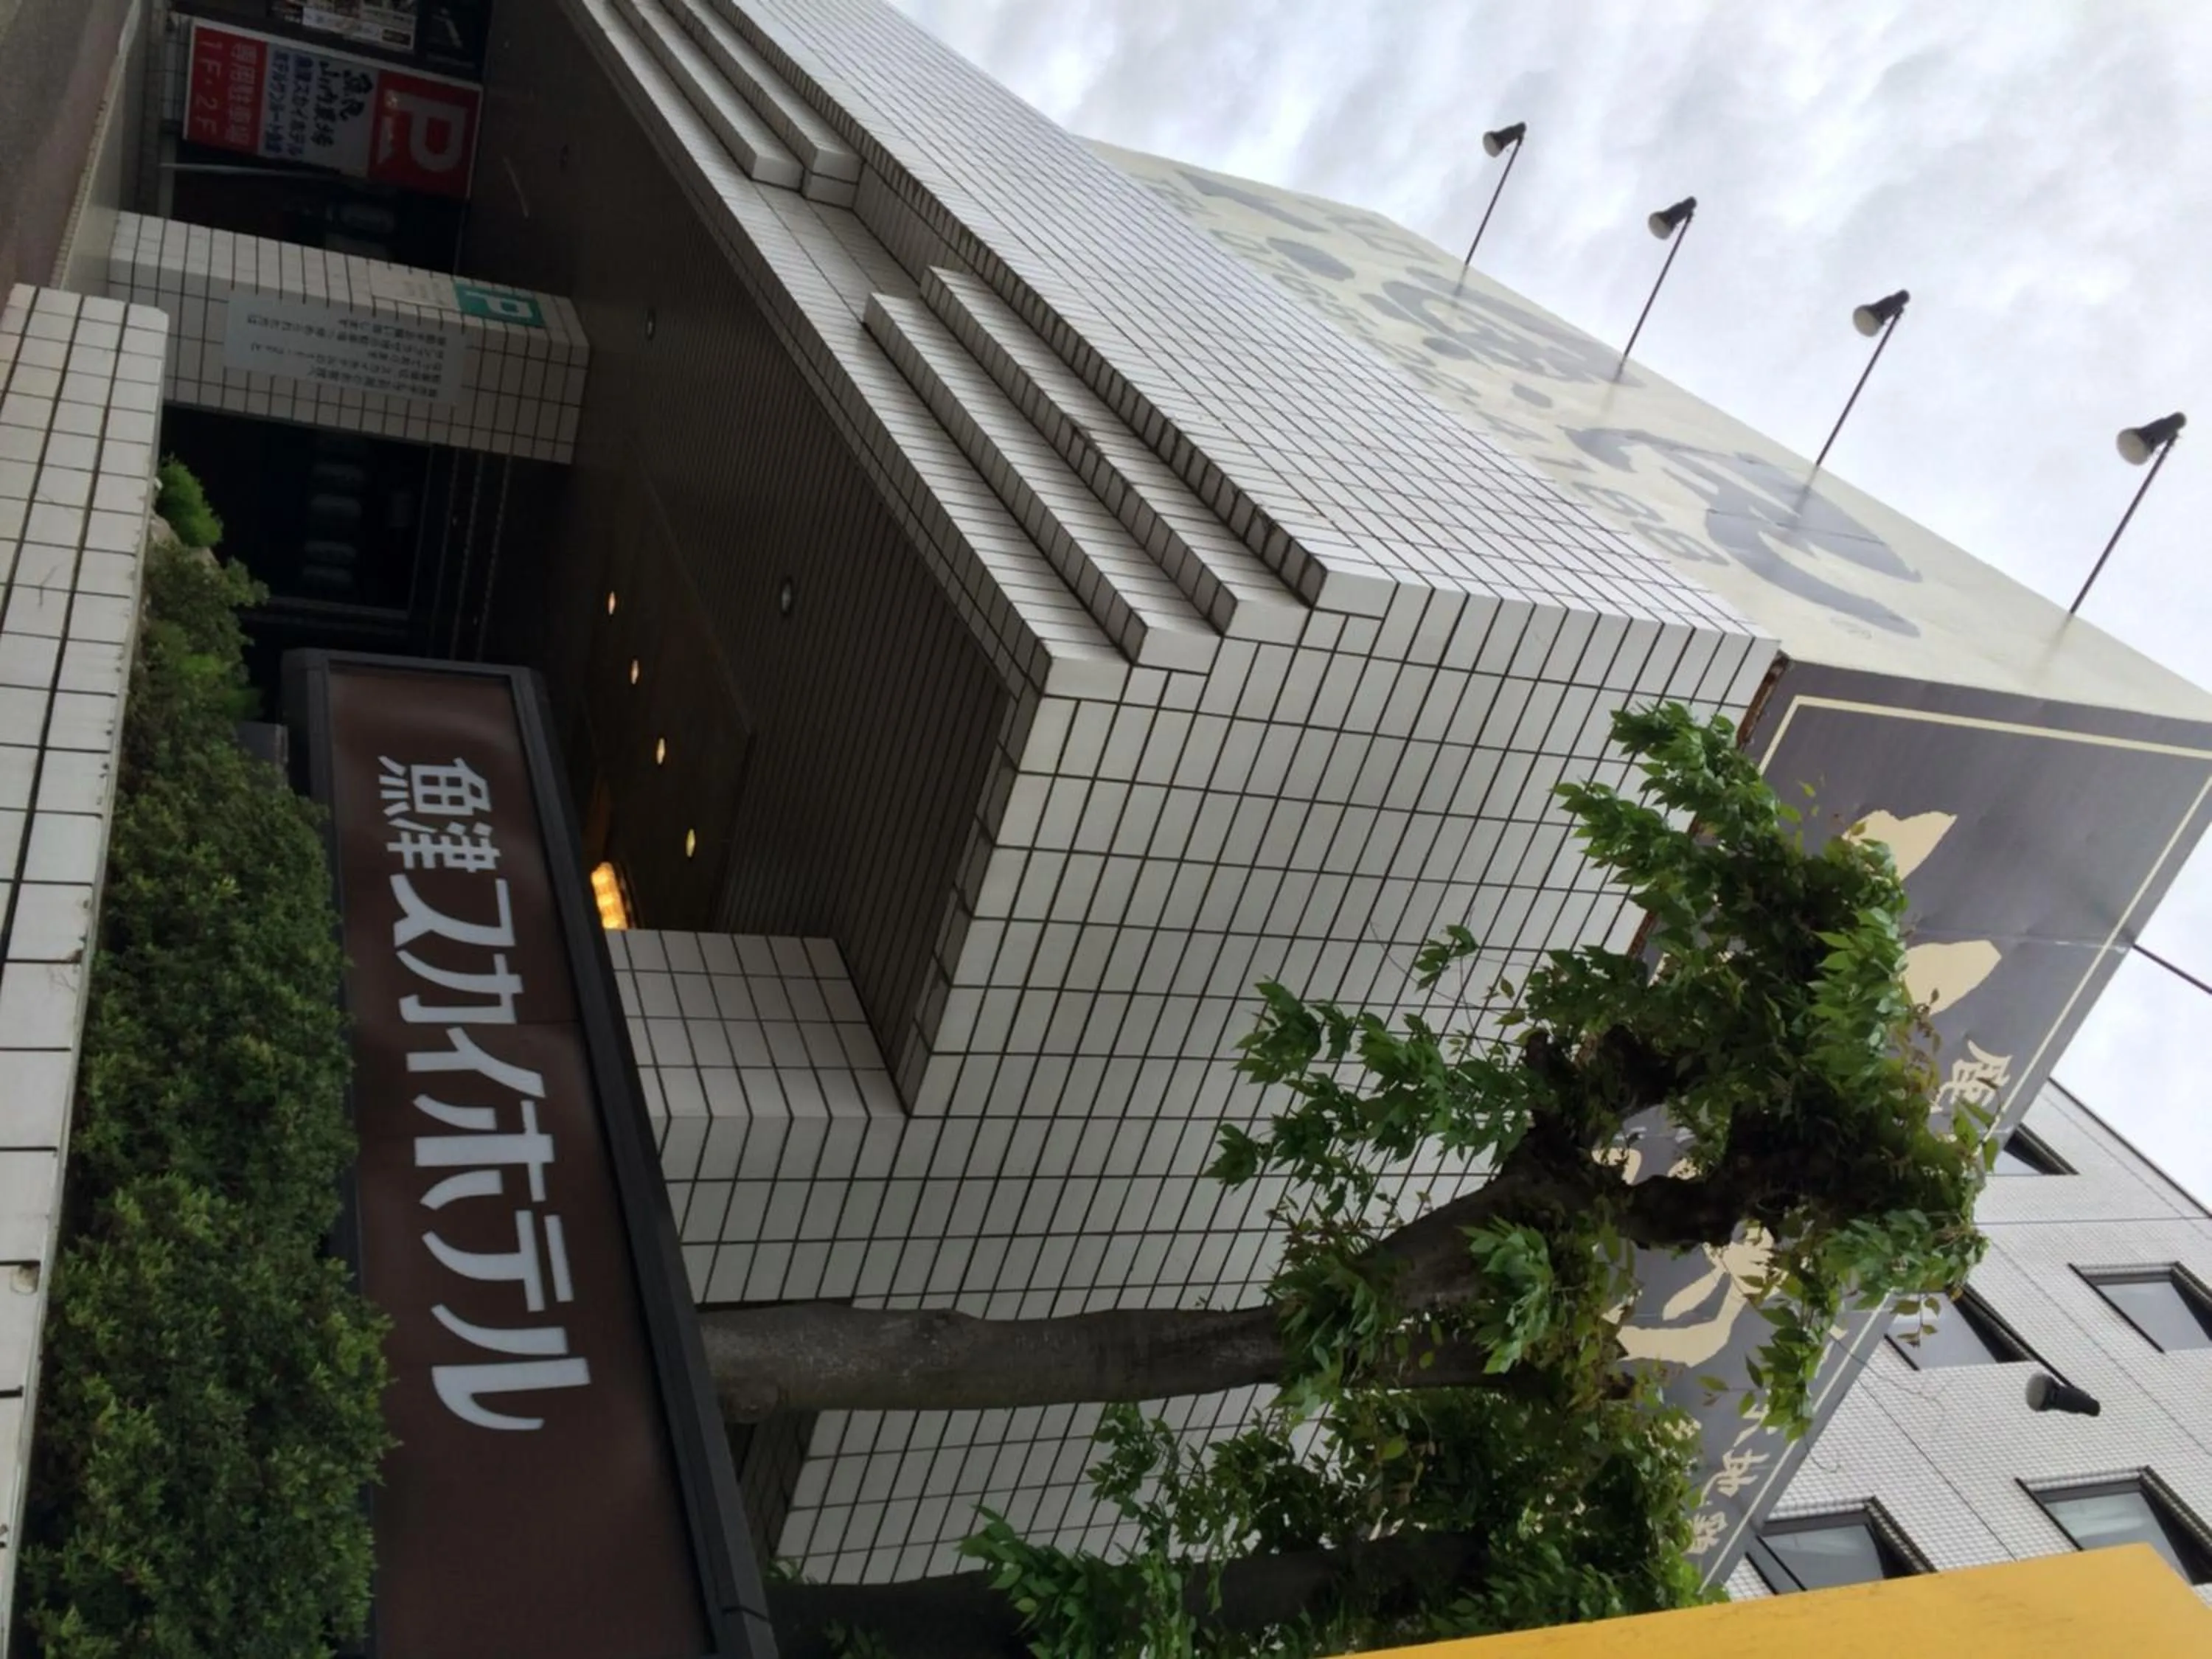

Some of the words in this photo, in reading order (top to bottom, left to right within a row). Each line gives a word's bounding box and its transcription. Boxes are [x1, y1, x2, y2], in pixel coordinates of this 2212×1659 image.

[226, 42, 257, 146] 専用駐車場
[384, 89, 468, 173] P
[465, 291, 534, 319] P
[377, 755, 591, 1432] 魚津スカイホテル
